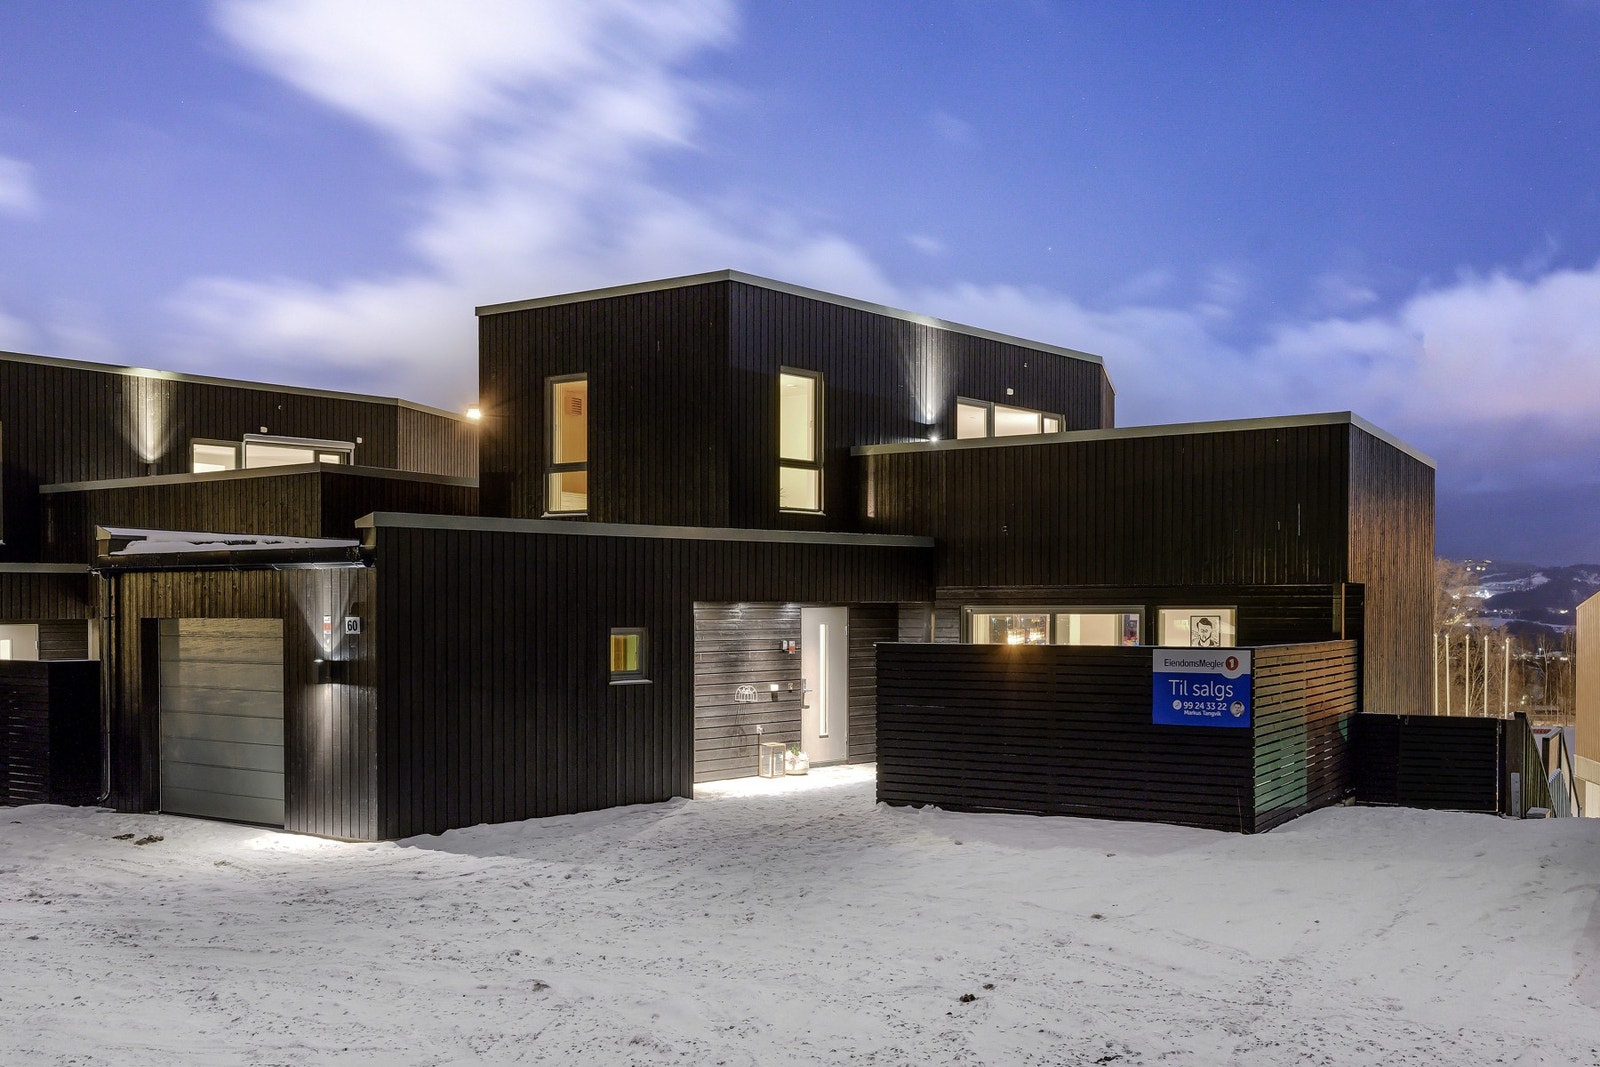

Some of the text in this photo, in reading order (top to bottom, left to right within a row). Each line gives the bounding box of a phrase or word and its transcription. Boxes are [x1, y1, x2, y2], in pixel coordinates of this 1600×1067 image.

[347, 620, 358, 631] 60
[1164, 658, 1224, 669] EiendomsMegler
[1168, 679, 1234, 701] Til salgs
[1183, 701, 1227, 711] 99 24 33 22
